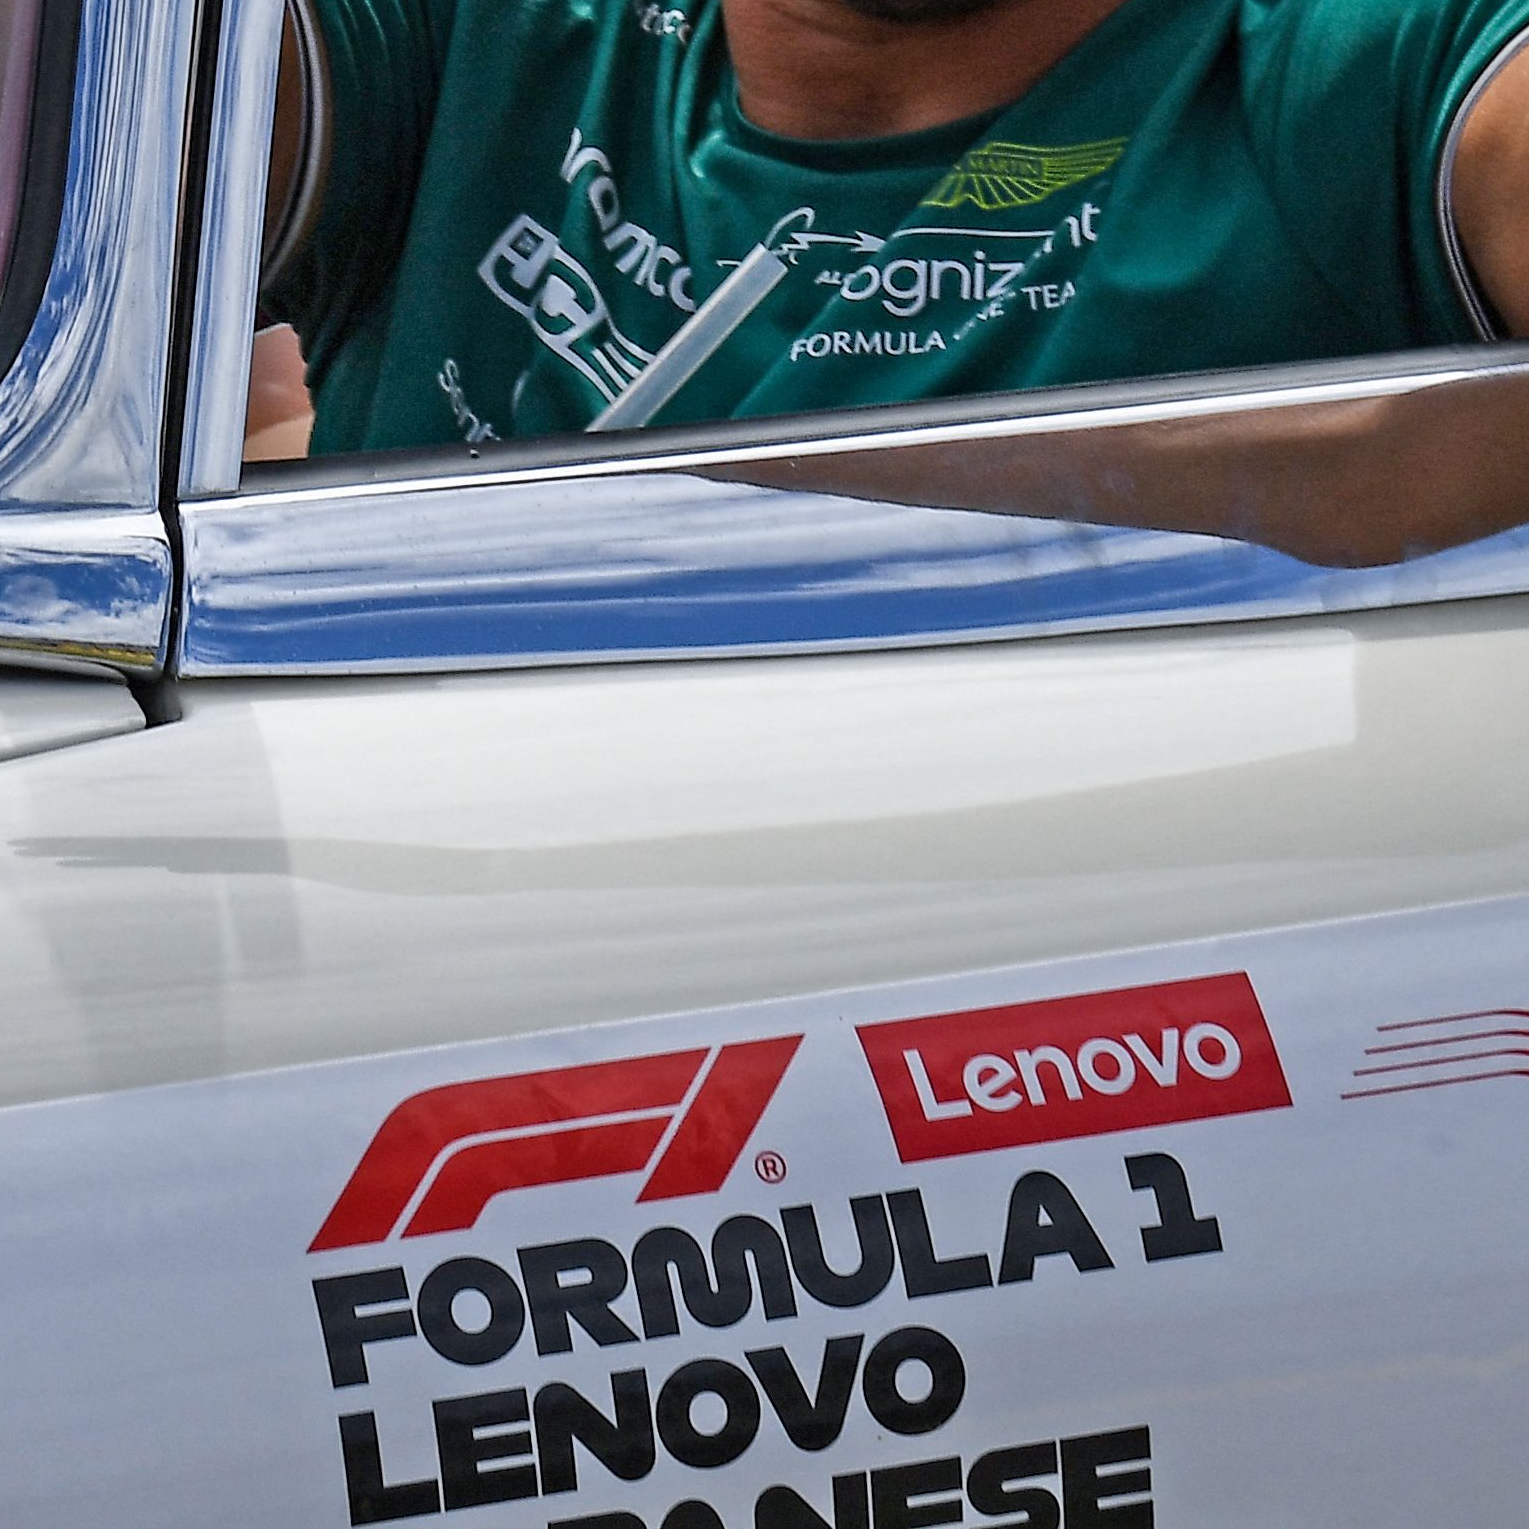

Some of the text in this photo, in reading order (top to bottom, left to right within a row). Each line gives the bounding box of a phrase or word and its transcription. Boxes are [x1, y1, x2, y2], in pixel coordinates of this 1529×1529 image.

[789, 329, 947, 361] FORMULA
[902, 1021, 1243, 1122] Lenovo
[311, 1152, 1224, 1390] FORMULA 1
[338, 1326, 966, 1528] LENOVO
